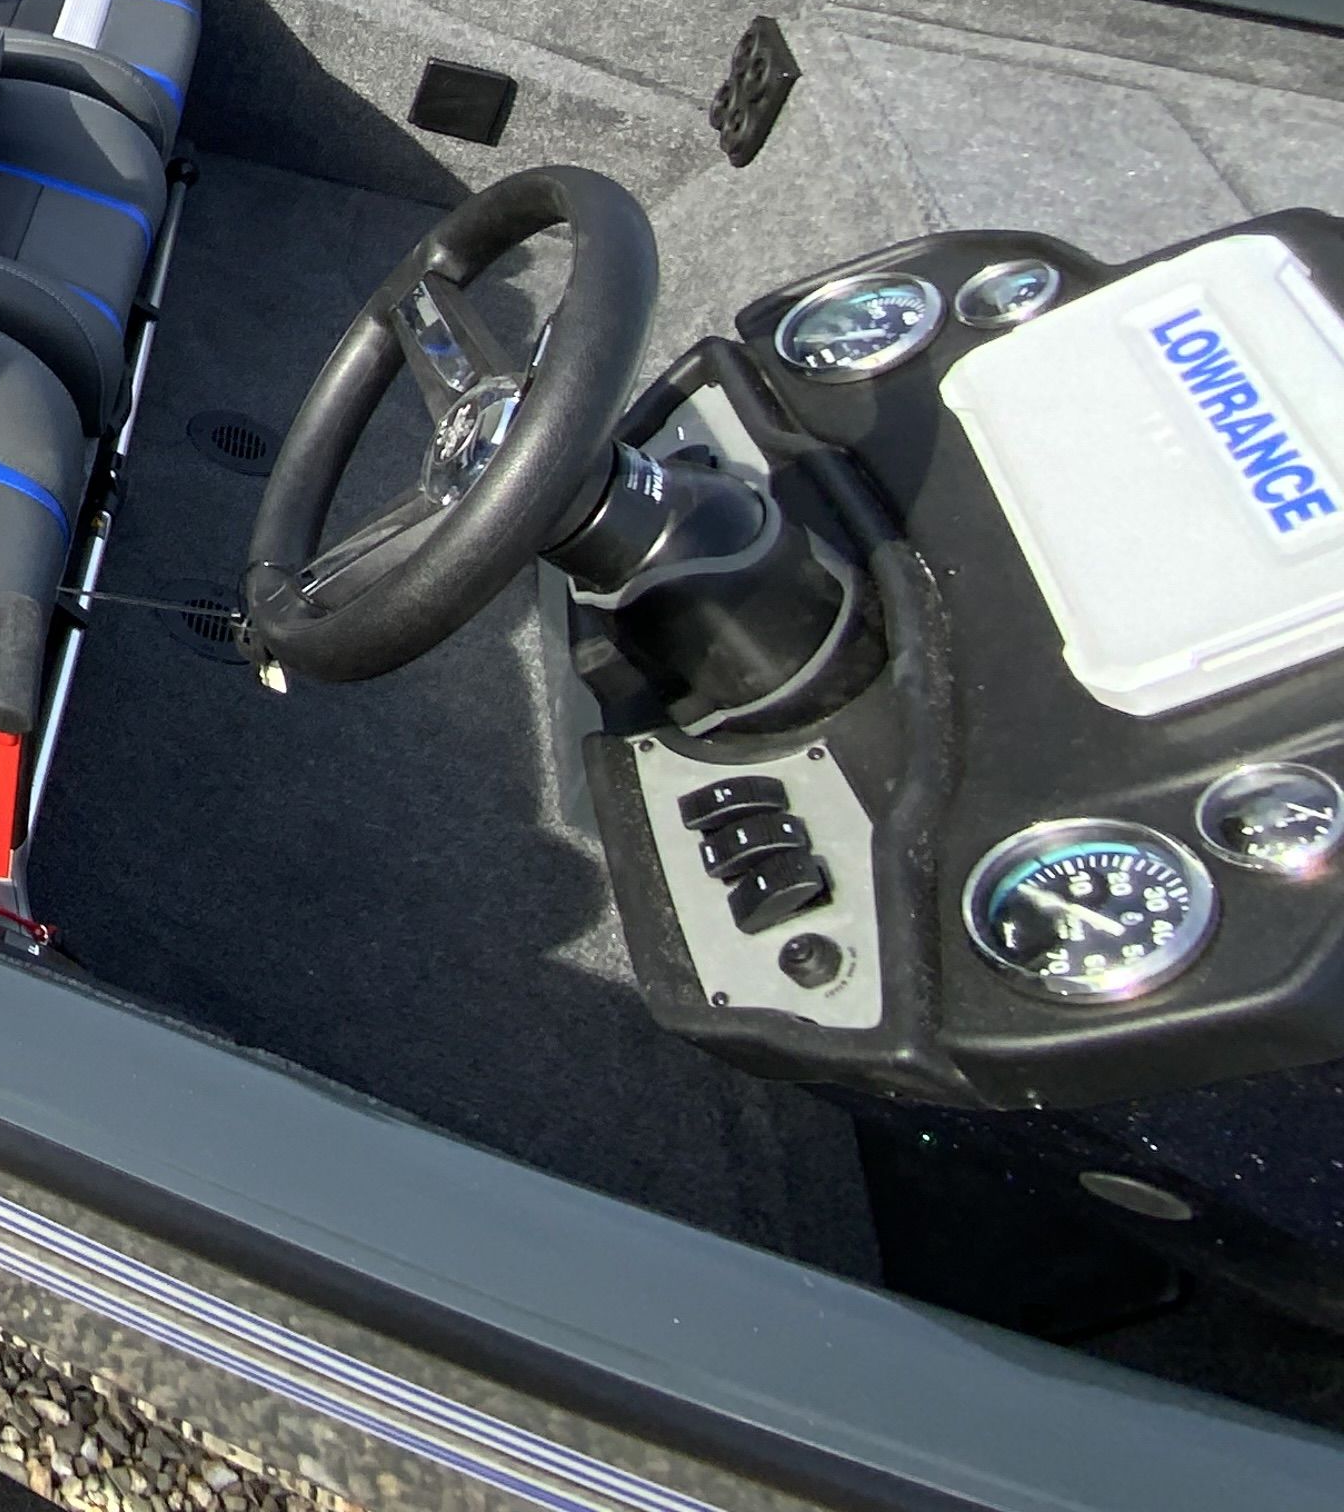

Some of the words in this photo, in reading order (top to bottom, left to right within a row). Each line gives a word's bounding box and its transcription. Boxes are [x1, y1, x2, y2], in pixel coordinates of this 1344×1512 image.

[1150, 308, 1338, 534] LOWRANCE
[1068, 870, 1093, 897] 10
[1106, 871, 1133, 897] 20
[1143, 886, 1170, 912] 30
[1151, 919, 1175, 946] 40
[1046, 948, 1070, 975] 70
